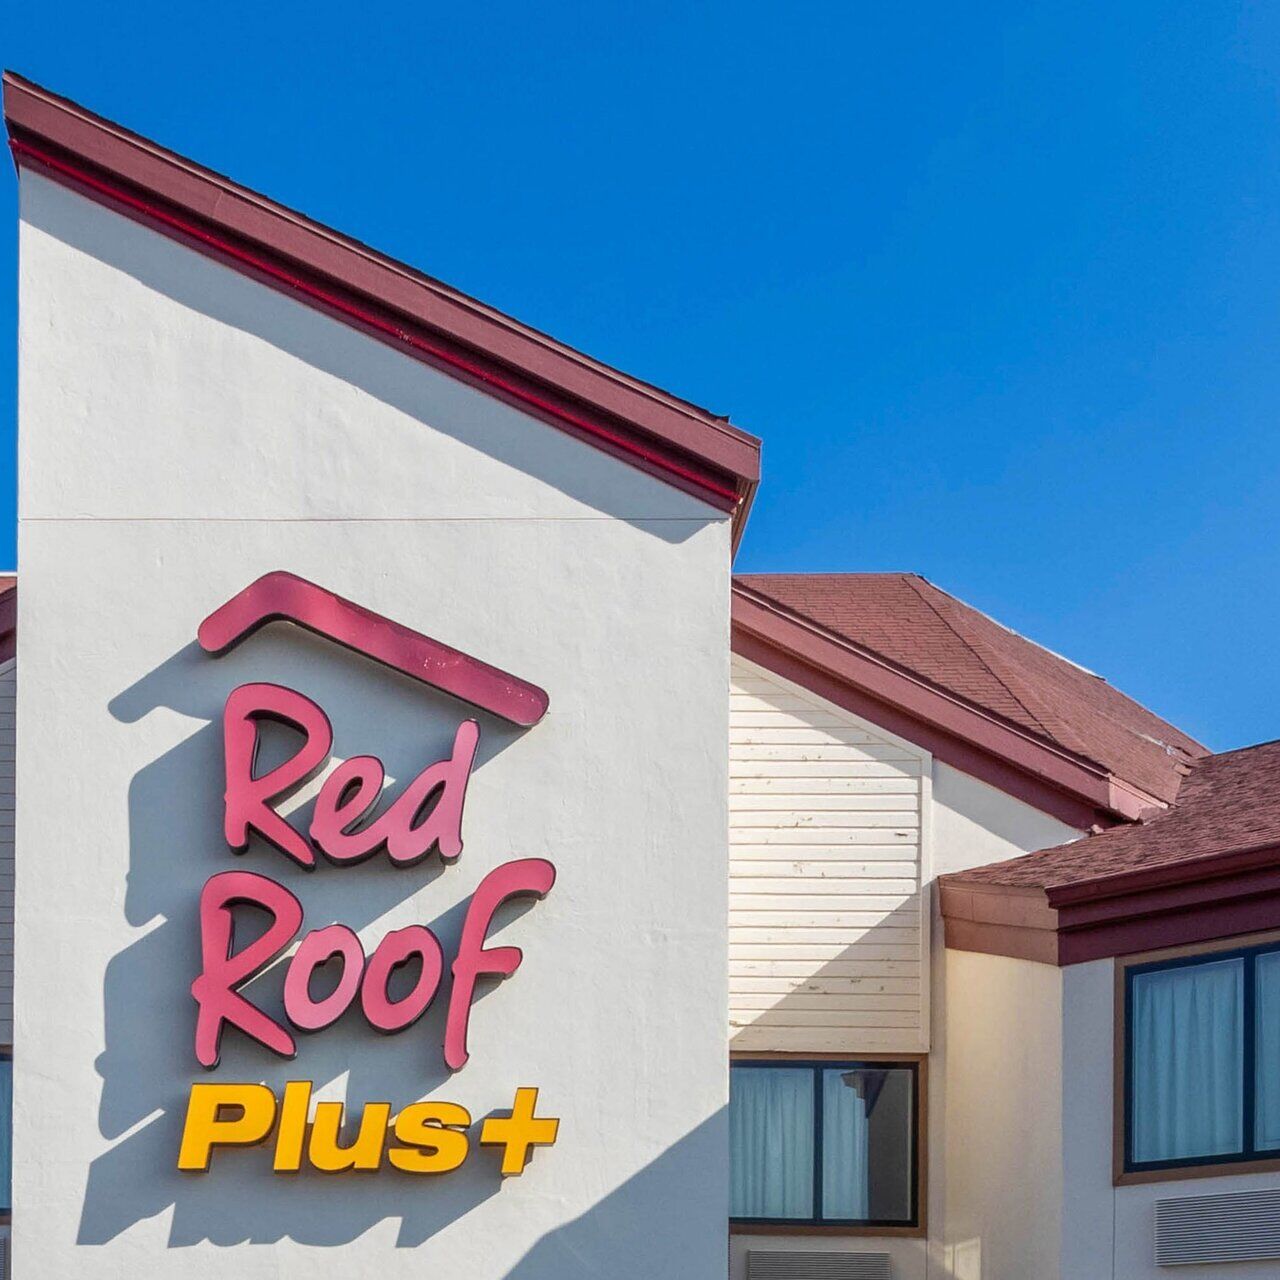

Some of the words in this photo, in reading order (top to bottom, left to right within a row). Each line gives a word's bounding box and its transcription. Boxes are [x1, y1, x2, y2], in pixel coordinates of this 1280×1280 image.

[223, 682, 480, 871] Red
[191, 857, 557, 1073] Roof
[177, 1080, 560, 1177] Plus+
